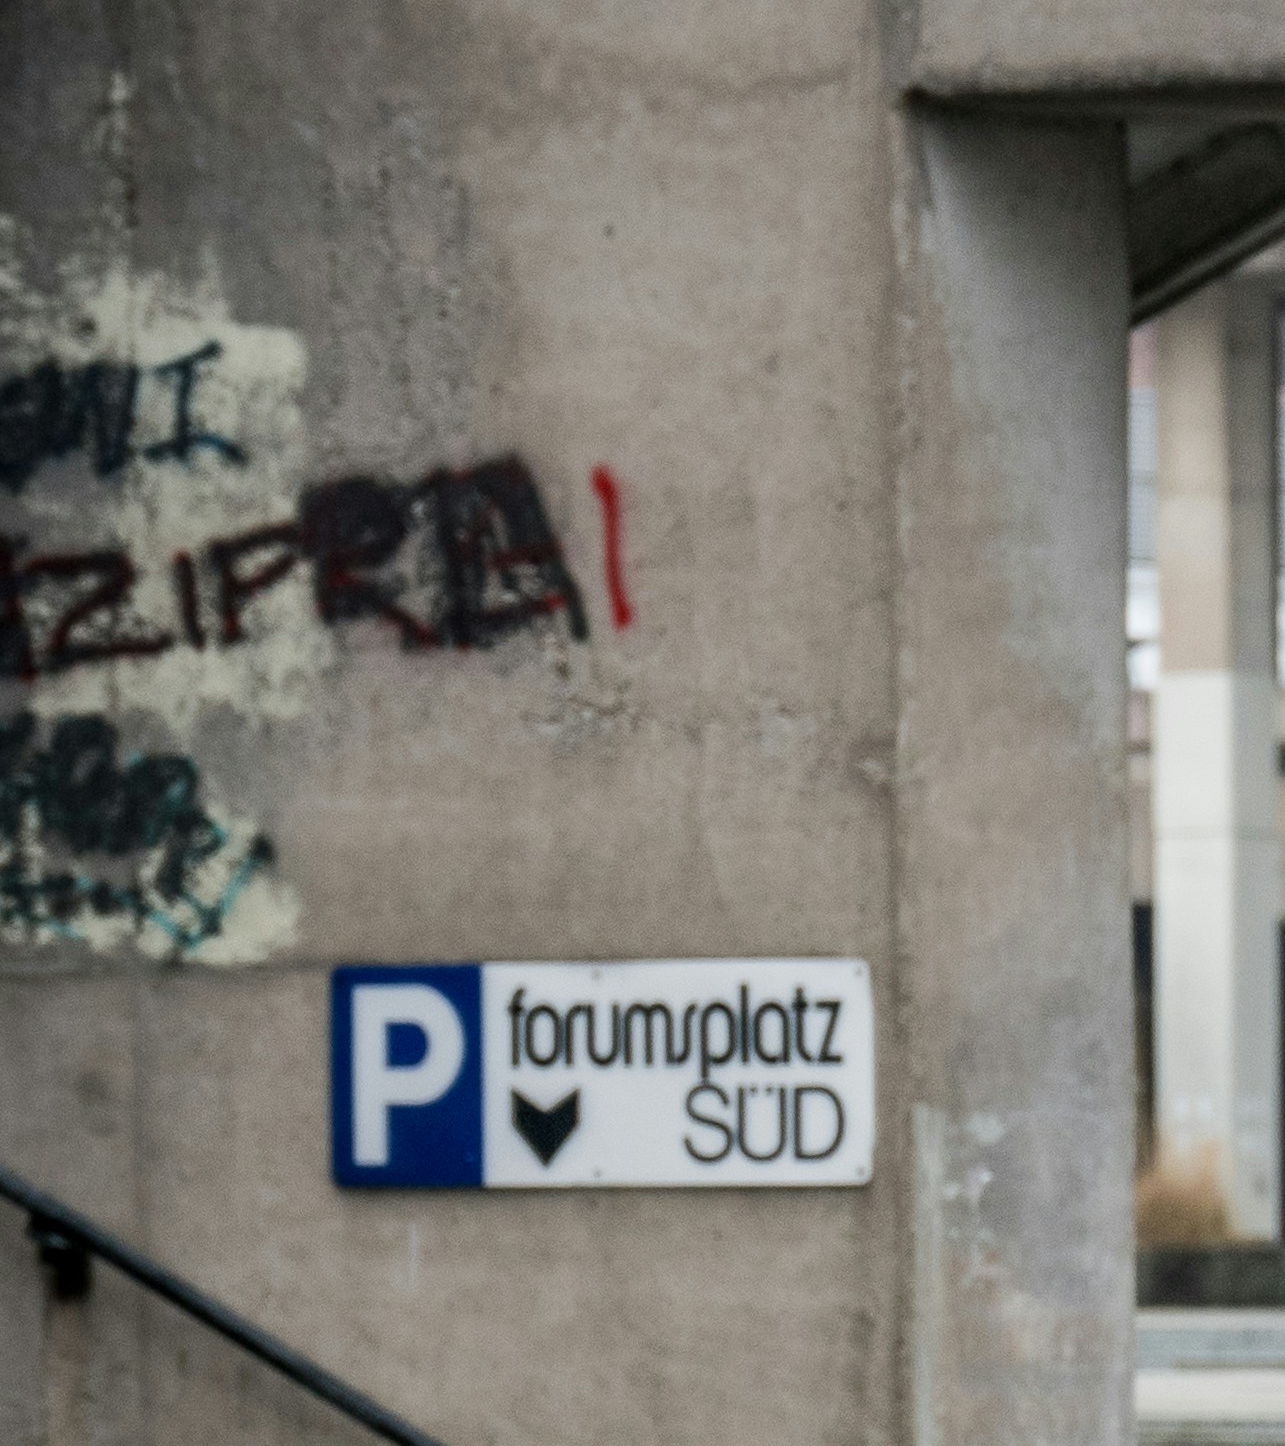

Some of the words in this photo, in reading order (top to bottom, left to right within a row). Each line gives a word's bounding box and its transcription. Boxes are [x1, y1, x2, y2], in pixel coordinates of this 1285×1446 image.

[351, 983, 466, 1167] P
[509, 982, 842, 1077] forumsplatz
[684, 1082, 846, 1163] SÜD
